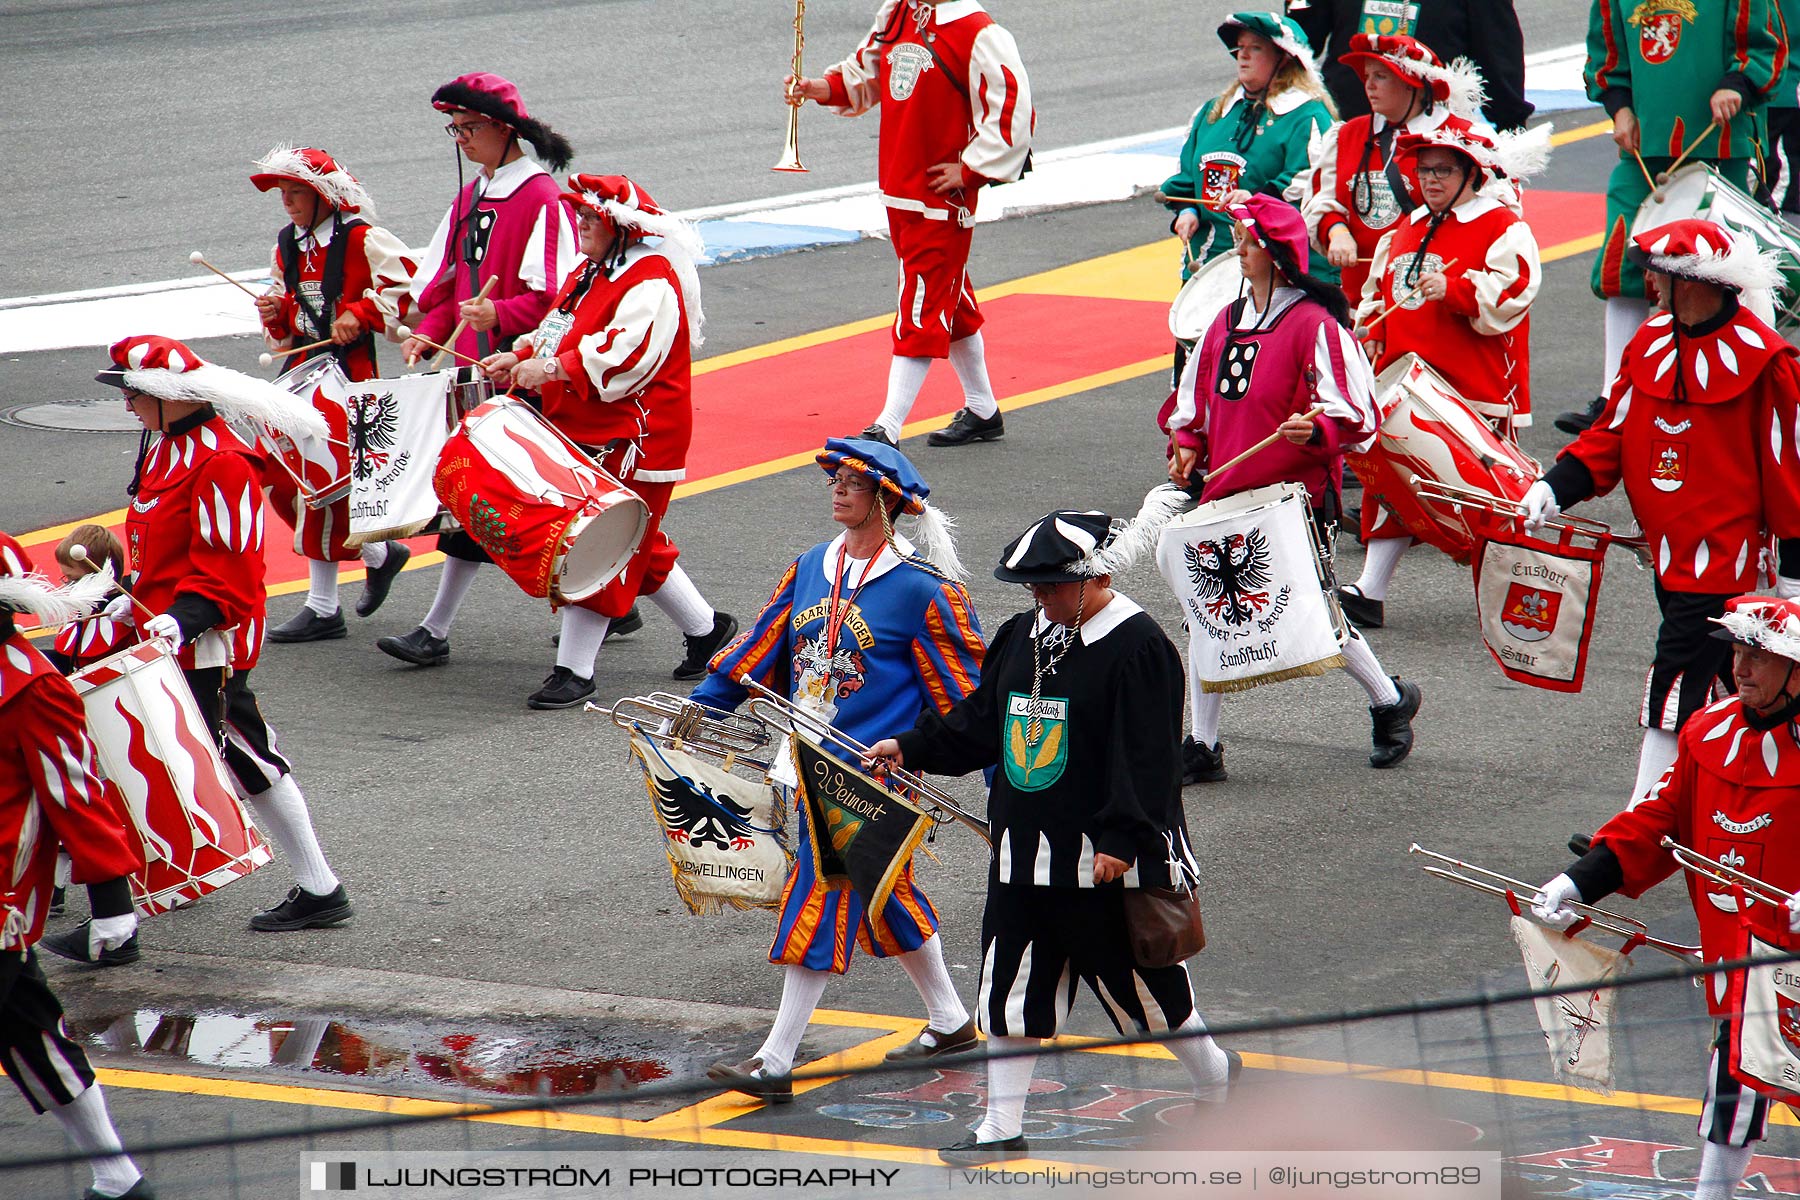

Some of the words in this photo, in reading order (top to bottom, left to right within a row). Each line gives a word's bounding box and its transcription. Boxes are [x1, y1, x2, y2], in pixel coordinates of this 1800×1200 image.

[1512, 562, 1568, 587] Ensdorf
[1258, 584, 1291, 633] Herolde
[1220, 640, 1279, 670] Landstuhl
[1501, 645, 1538, 666] Saar
[814, 760, 887, 820] Weinort
